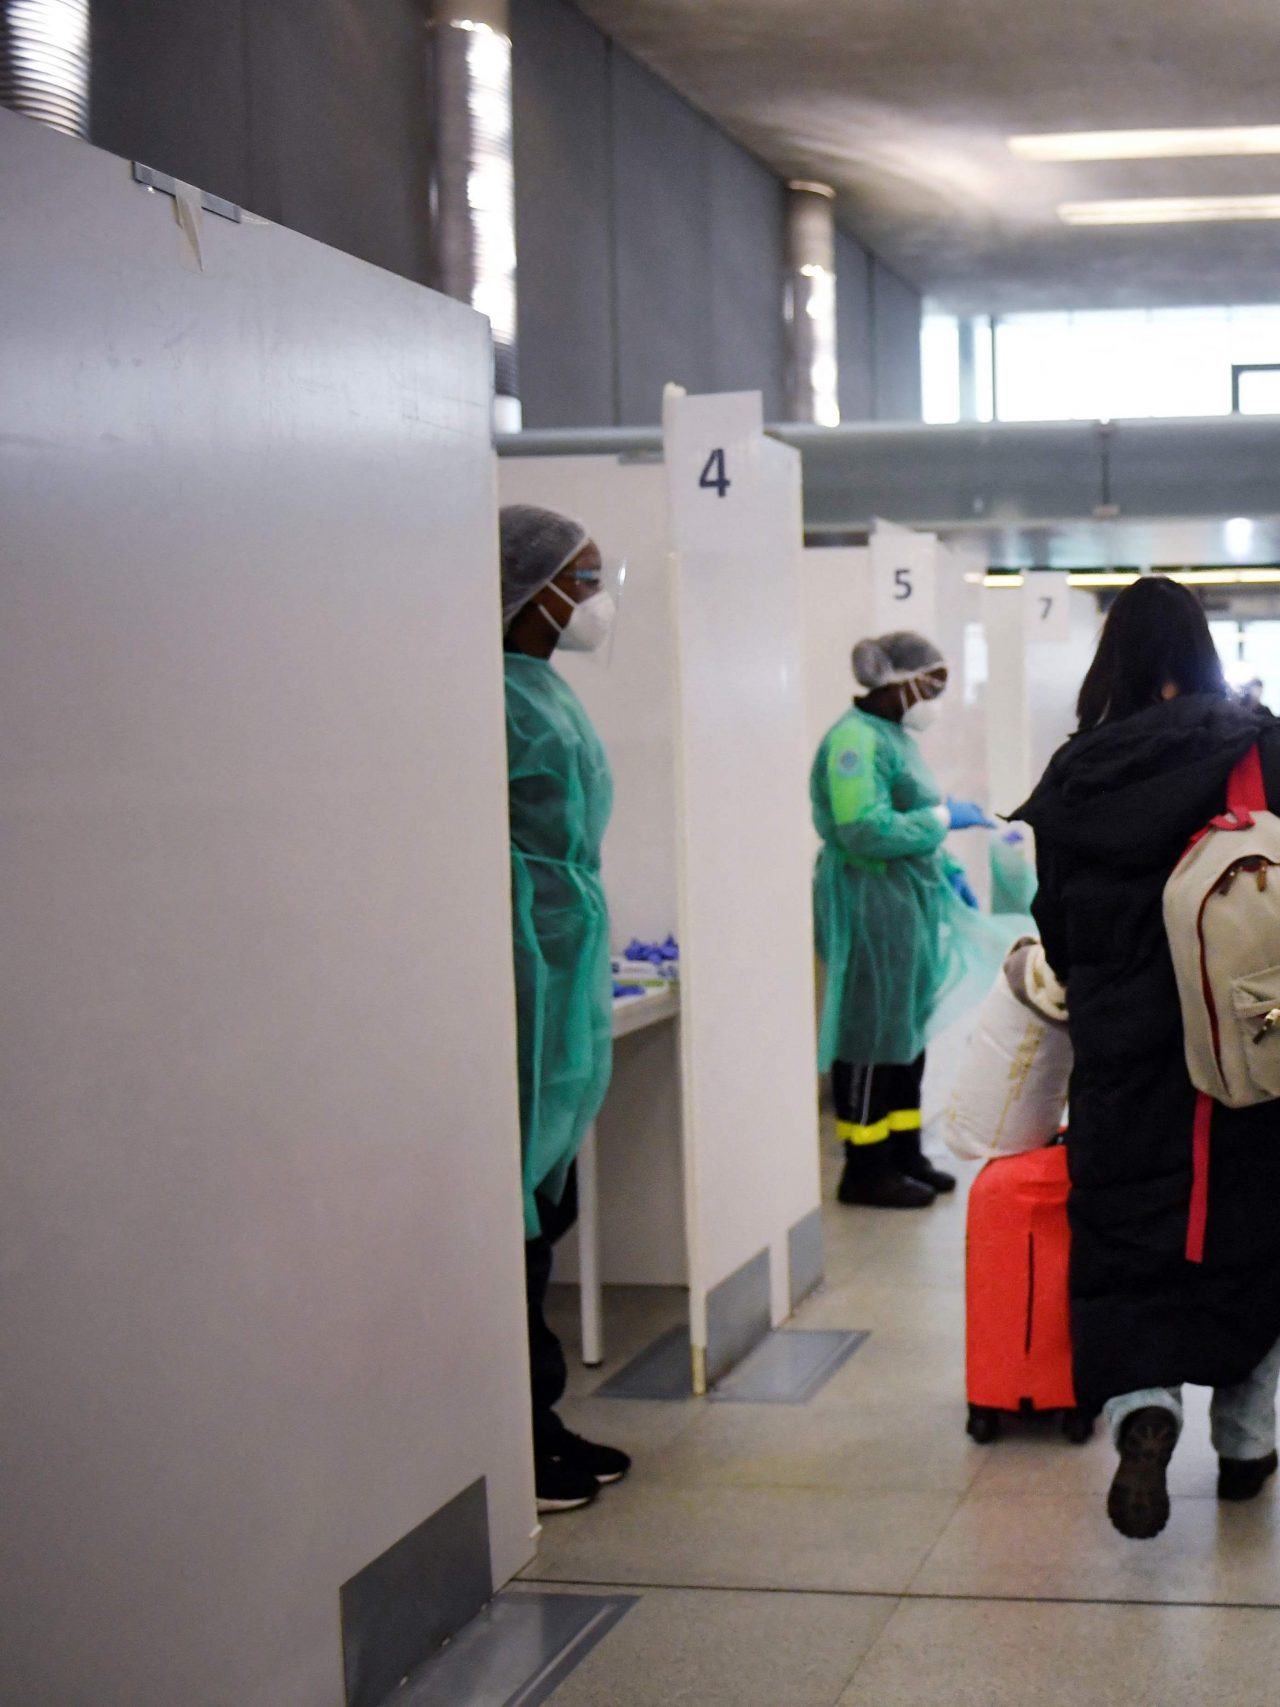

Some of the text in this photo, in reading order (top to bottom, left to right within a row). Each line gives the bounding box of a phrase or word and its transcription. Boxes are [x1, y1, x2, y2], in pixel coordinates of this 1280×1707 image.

[699, 448, 731, 498] 4
[894, 569, 912, 600] 5
[1039, 596, 1053, 620] 7
